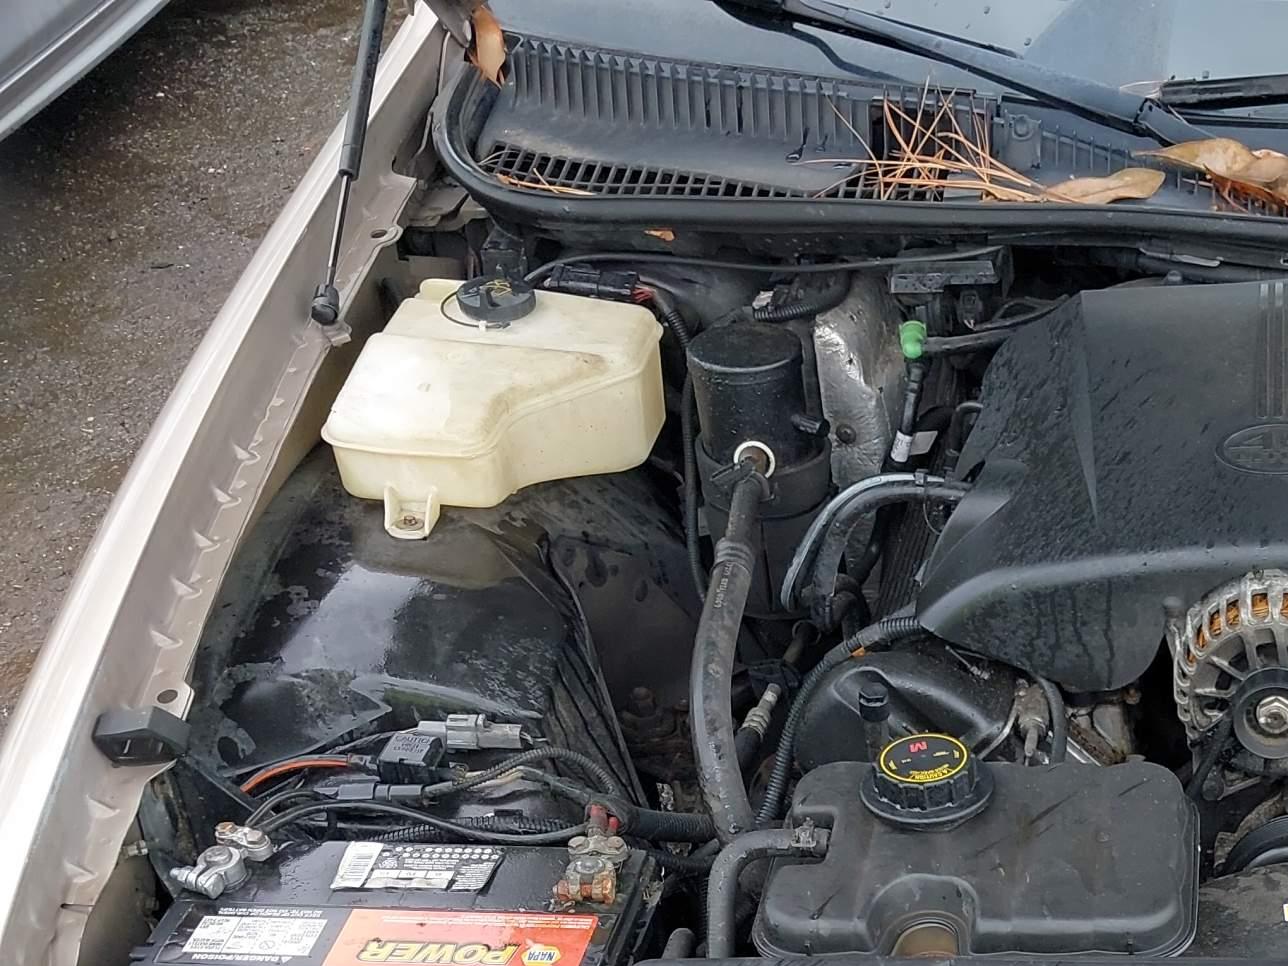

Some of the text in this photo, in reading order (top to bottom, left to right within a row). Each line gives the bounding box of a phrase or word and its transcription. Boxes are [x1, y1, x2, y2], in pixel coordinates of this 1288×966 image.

[192, 953, 281, 962] DANGER/POISON
[357, 941, 555, 966] NAPA POWER
